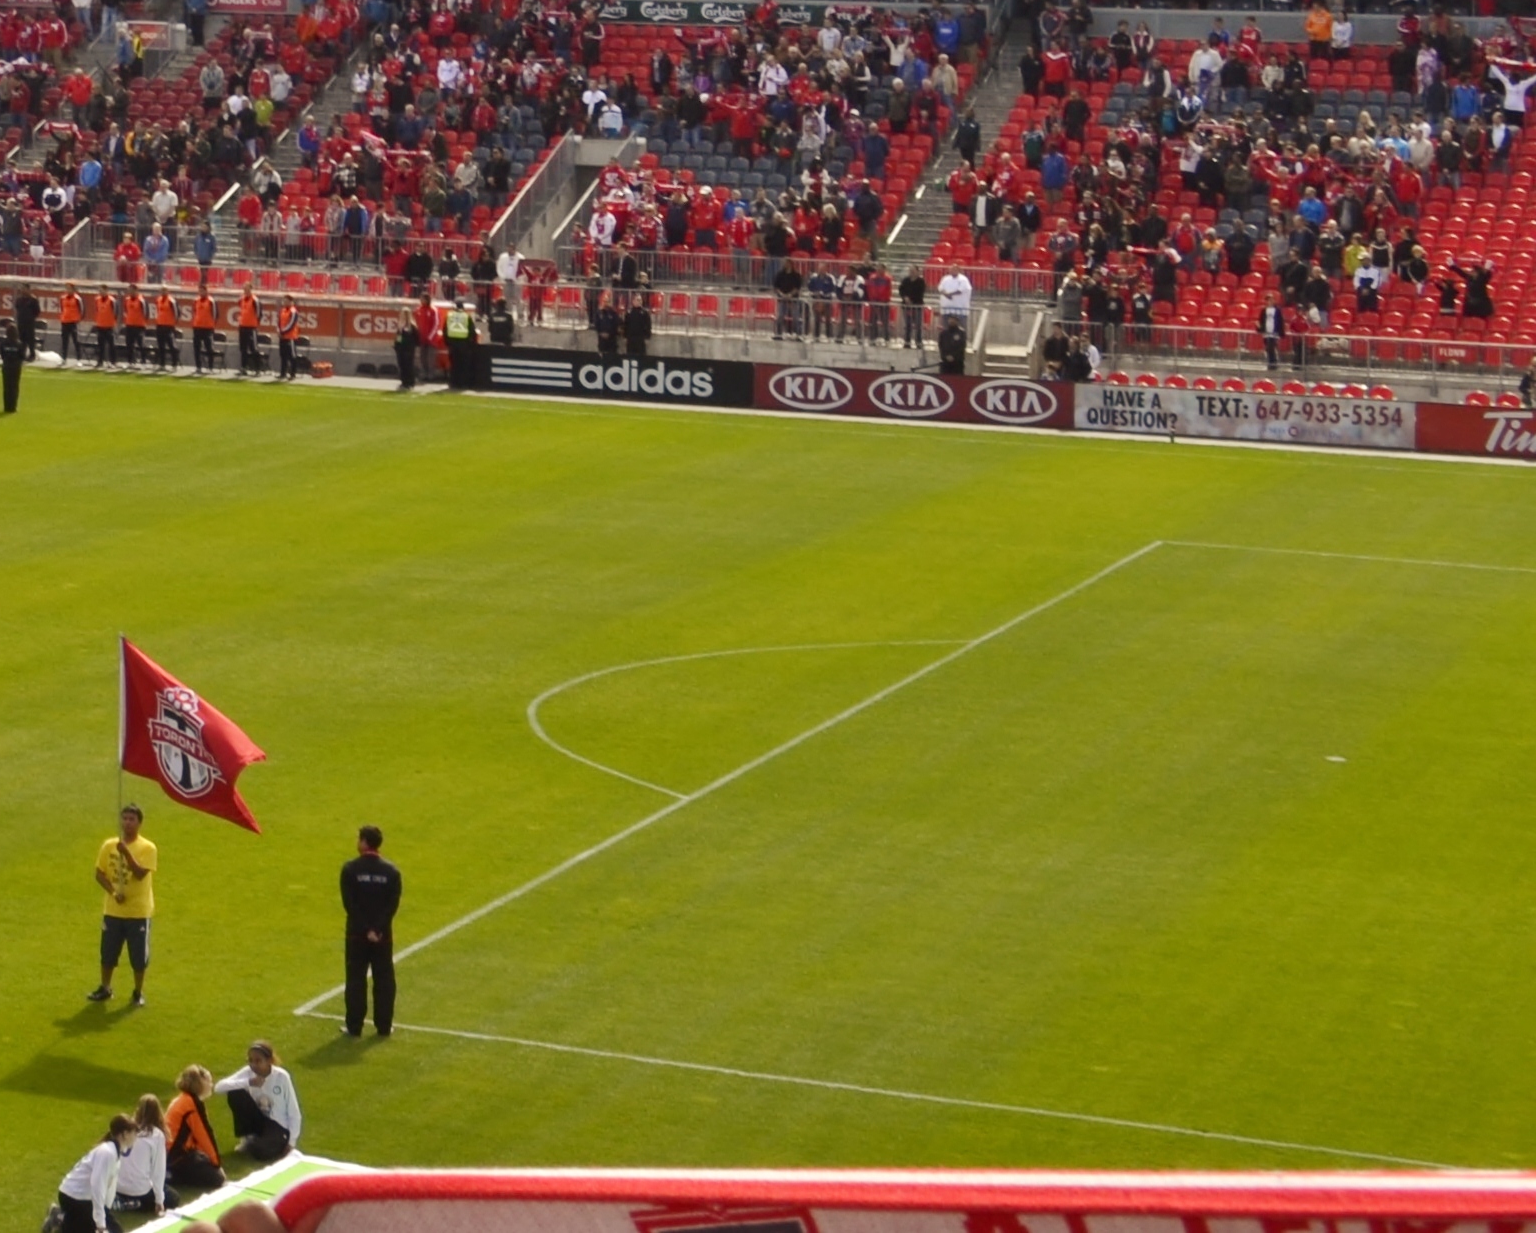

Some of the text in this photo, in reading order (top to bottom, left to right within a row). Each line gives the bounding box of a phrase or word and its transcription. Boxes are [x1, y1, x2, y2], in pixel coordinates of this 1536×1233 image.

[640, 1, 688, 21] Carlsberg
[579, 359, 714, 398] adidas
[783, 375, 840, 402] KIA
[883, 382, 941, 408] KIA
[985, 388, 1044, 415] KIA
[1103, 389, 1161, 409] HAVE A
[1087, 407, 1178, 430] QUESTION?
[1195, 396, 1403, 428] TEXT: 647-933-5354
